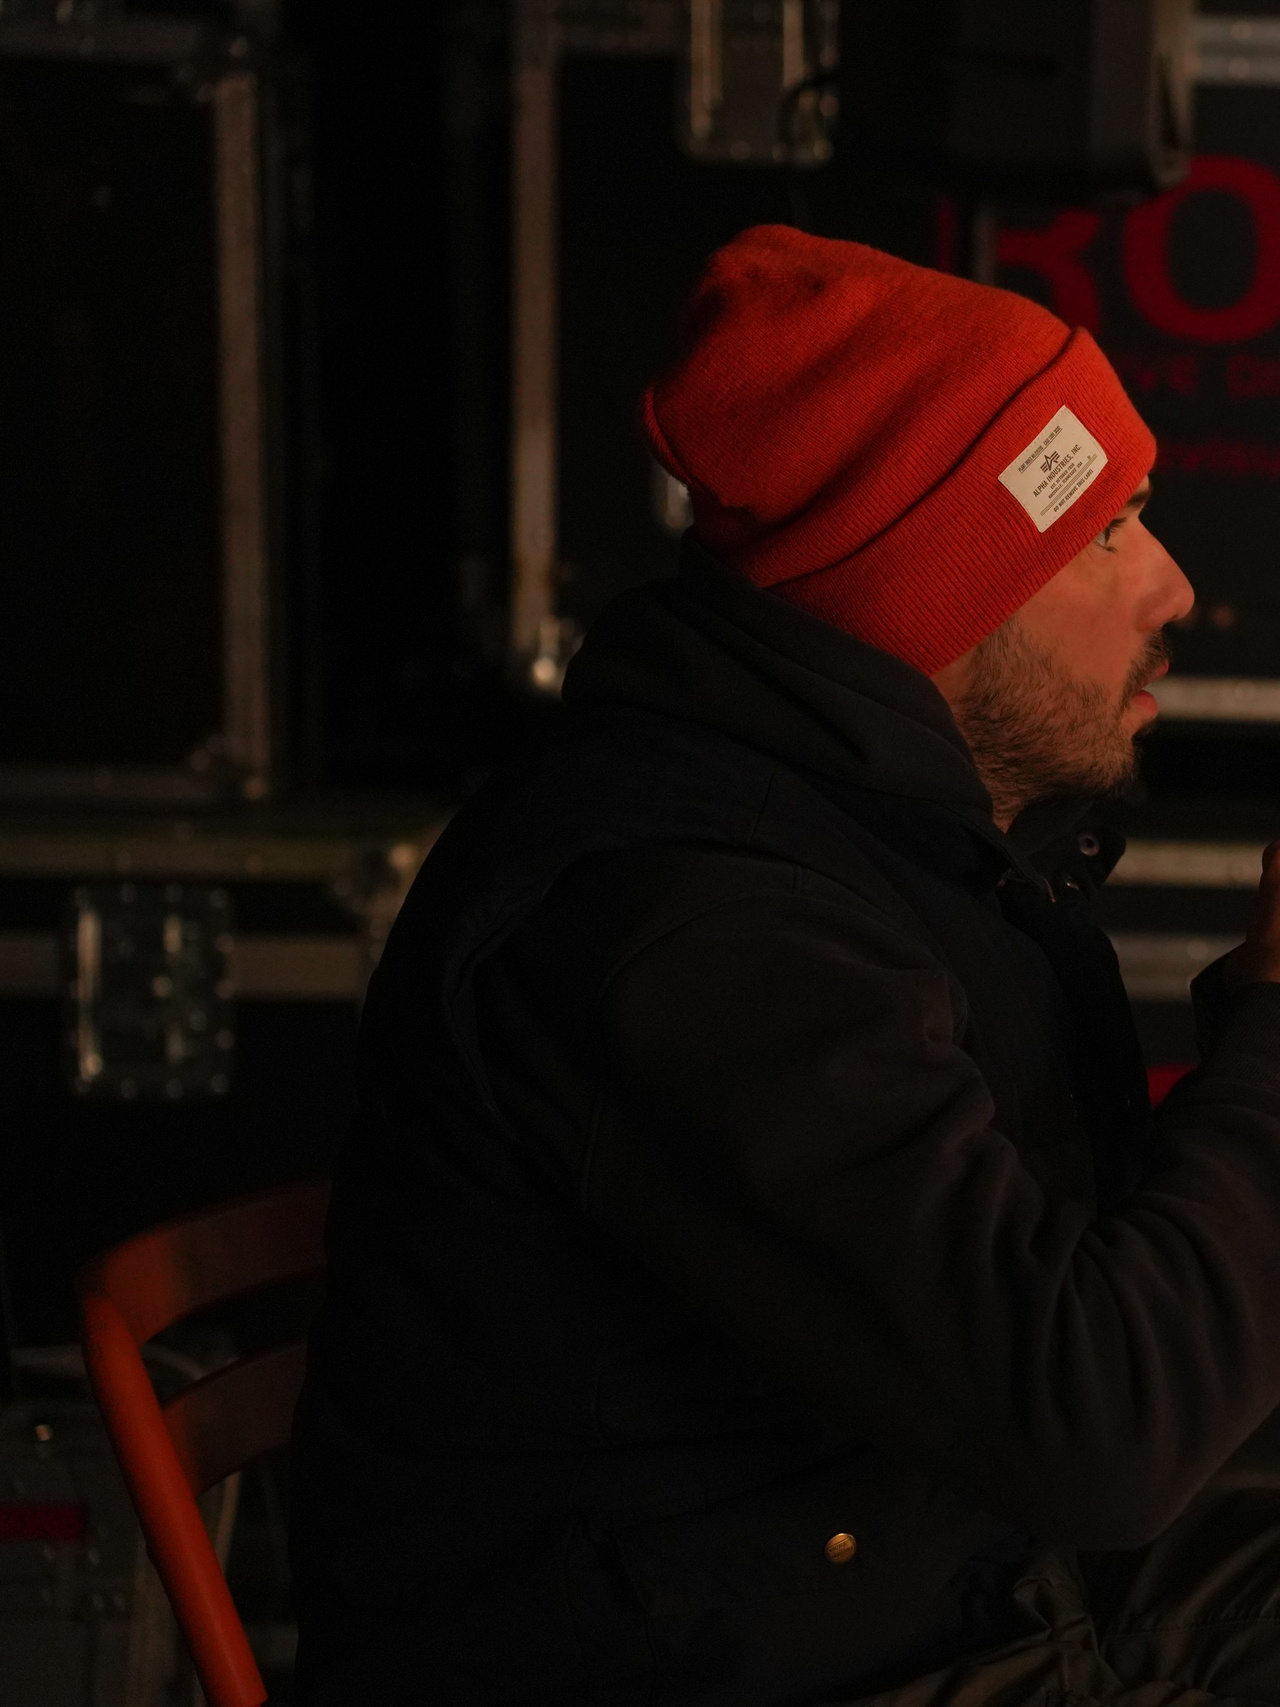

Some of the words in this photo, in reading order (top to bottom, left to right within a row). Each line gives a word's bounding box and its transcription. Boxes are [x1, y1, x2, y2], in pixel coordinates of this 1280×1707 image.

[1033, 480, 1048, 497] ALPHA
[1046, 453, 1074, 482] INDUSTRIES,
[1071, 444, 1082, 455] INC.
[1053, 505, 1060, 513] DO
[1065, 485, 1078, 500] REMOVE
[1077, 477, 1085, 487] THIS
[1085, 469, 1094, 480] LABEL
